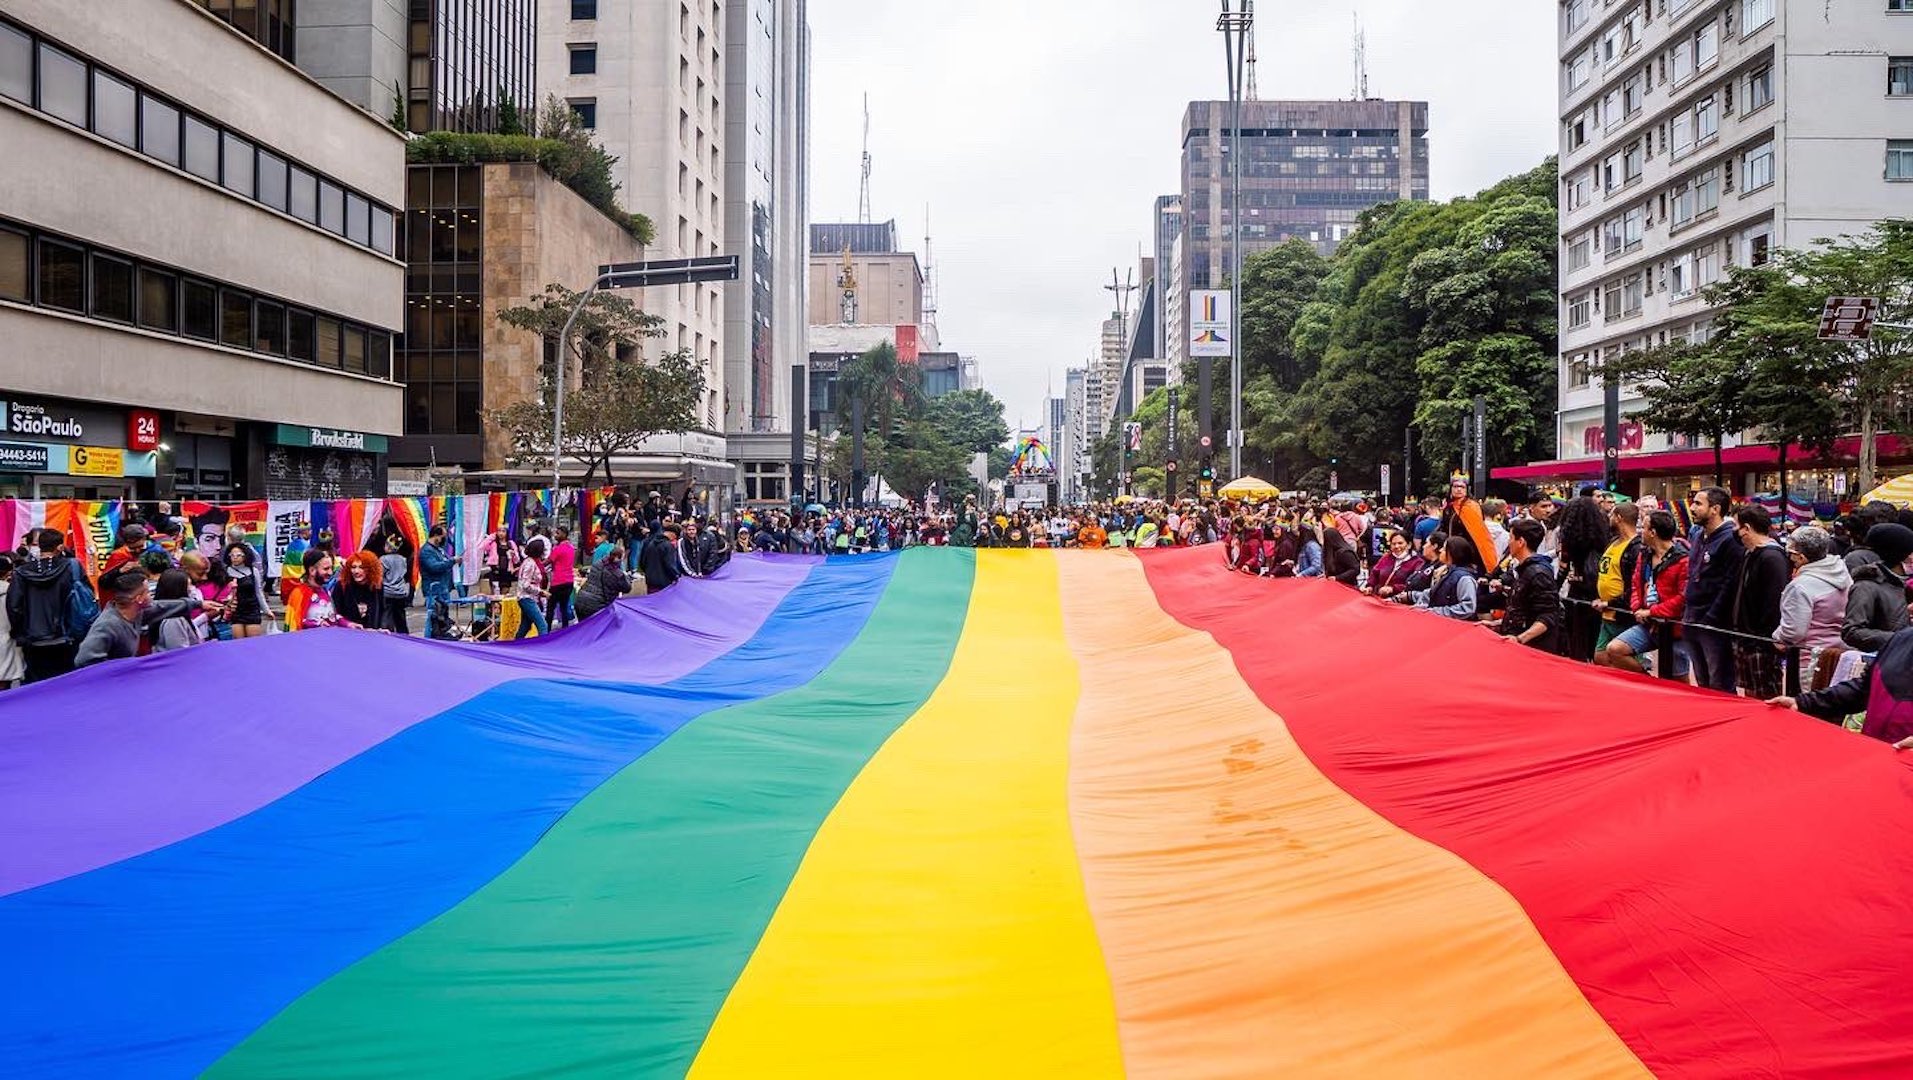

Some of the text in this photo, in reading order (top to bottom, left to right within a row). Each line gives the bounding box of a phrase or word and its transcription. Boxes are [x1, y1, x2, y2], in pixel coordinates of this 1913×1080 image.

[12, 402, 44, 413] Drogaria
[137, 416, 156, 434] 24
[75, 447, 88, 466] G
